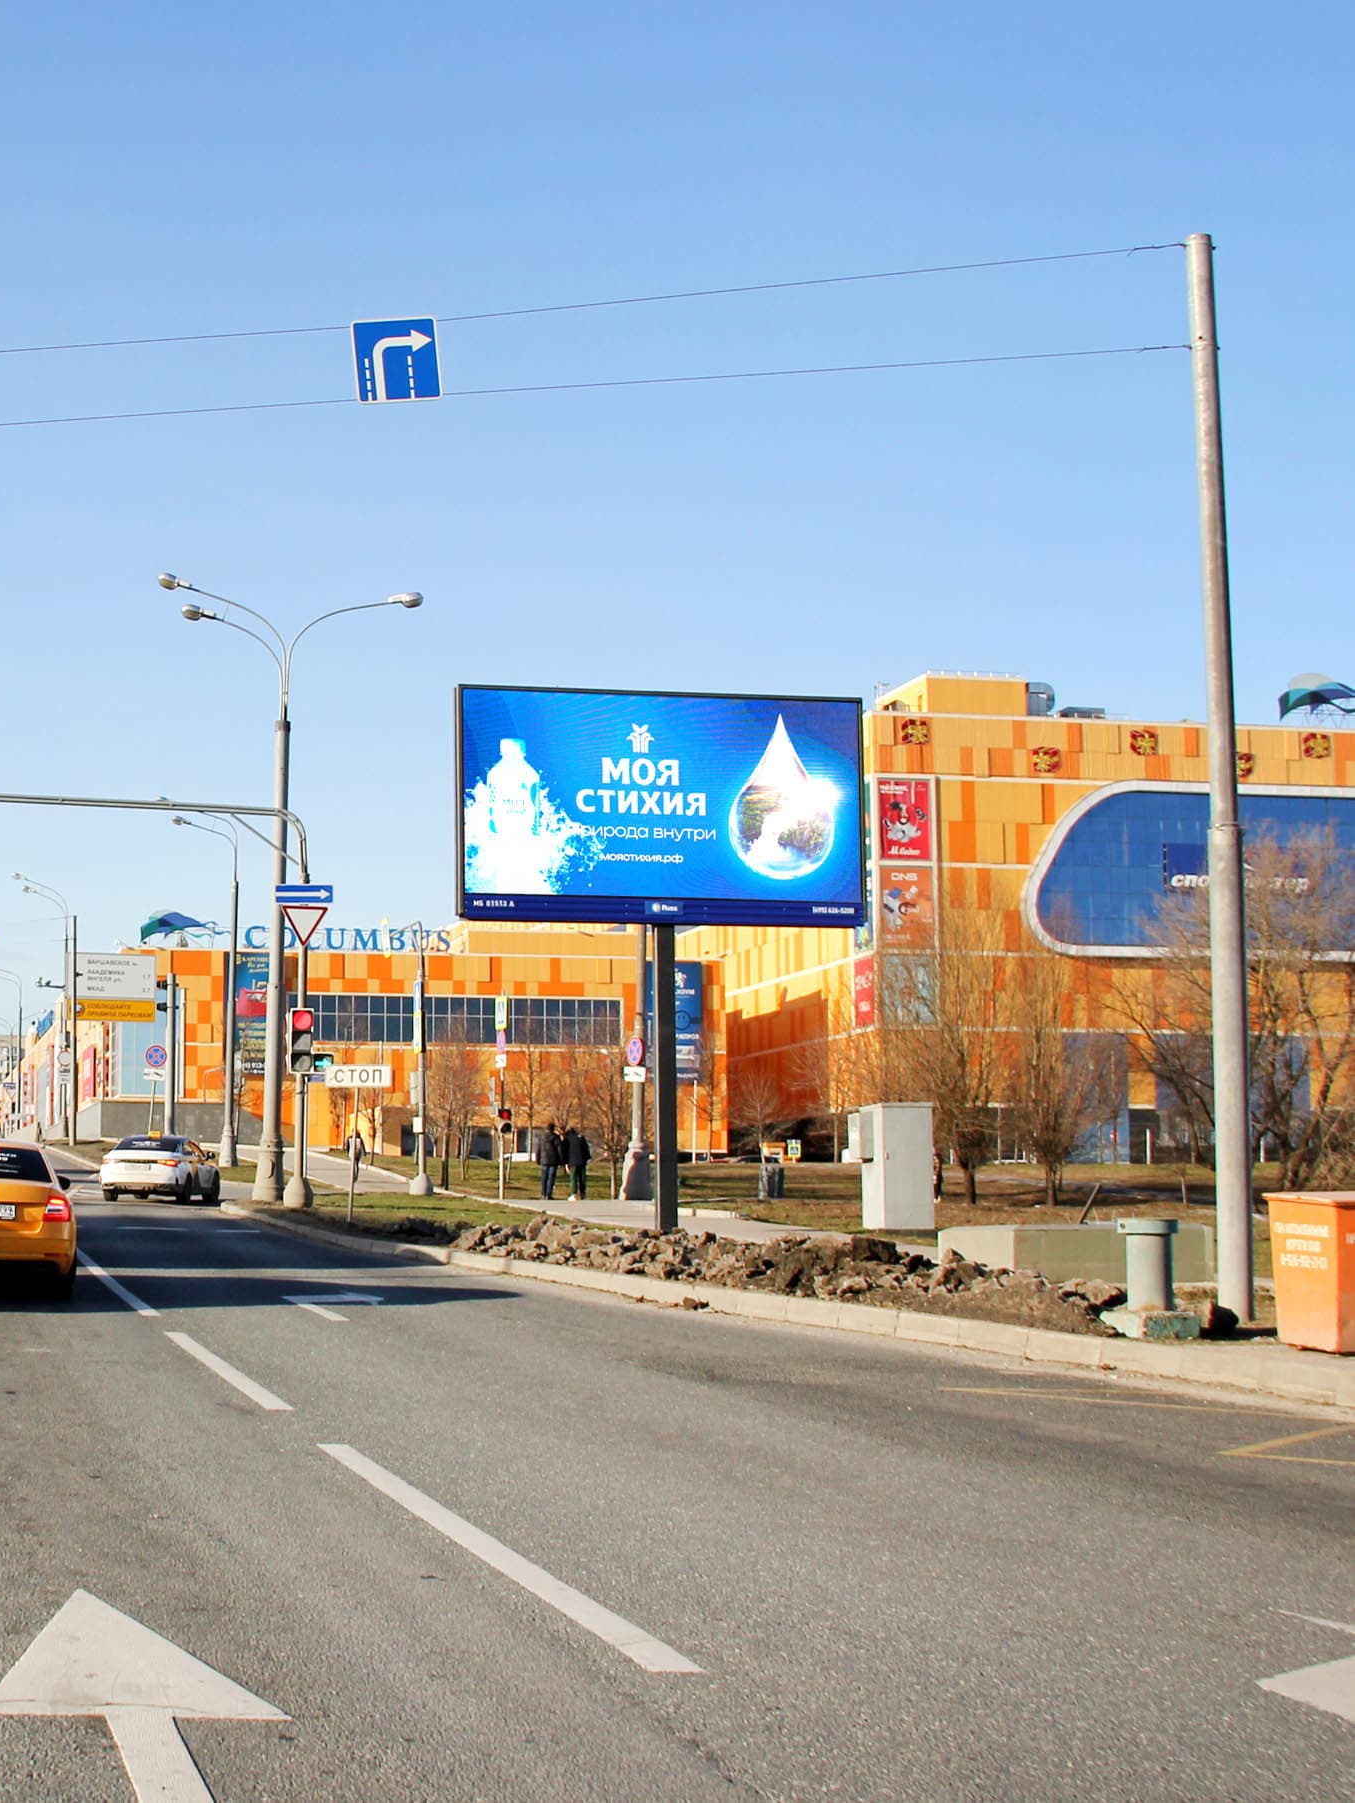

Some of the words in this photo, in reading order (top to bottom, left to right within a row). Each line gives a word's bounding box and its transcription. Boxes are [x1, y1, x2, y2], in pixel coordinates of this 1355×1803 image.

[601, 757, 679, 786] МОЯ
[575, 788, 707, 817] СТИХИЯ
[571, 825, 649, 840] рирода
[653, 827, 717, 842] внутри
[891, 872, 918, 881] DNS
[334, 1068, 383, 1084] СТОП
